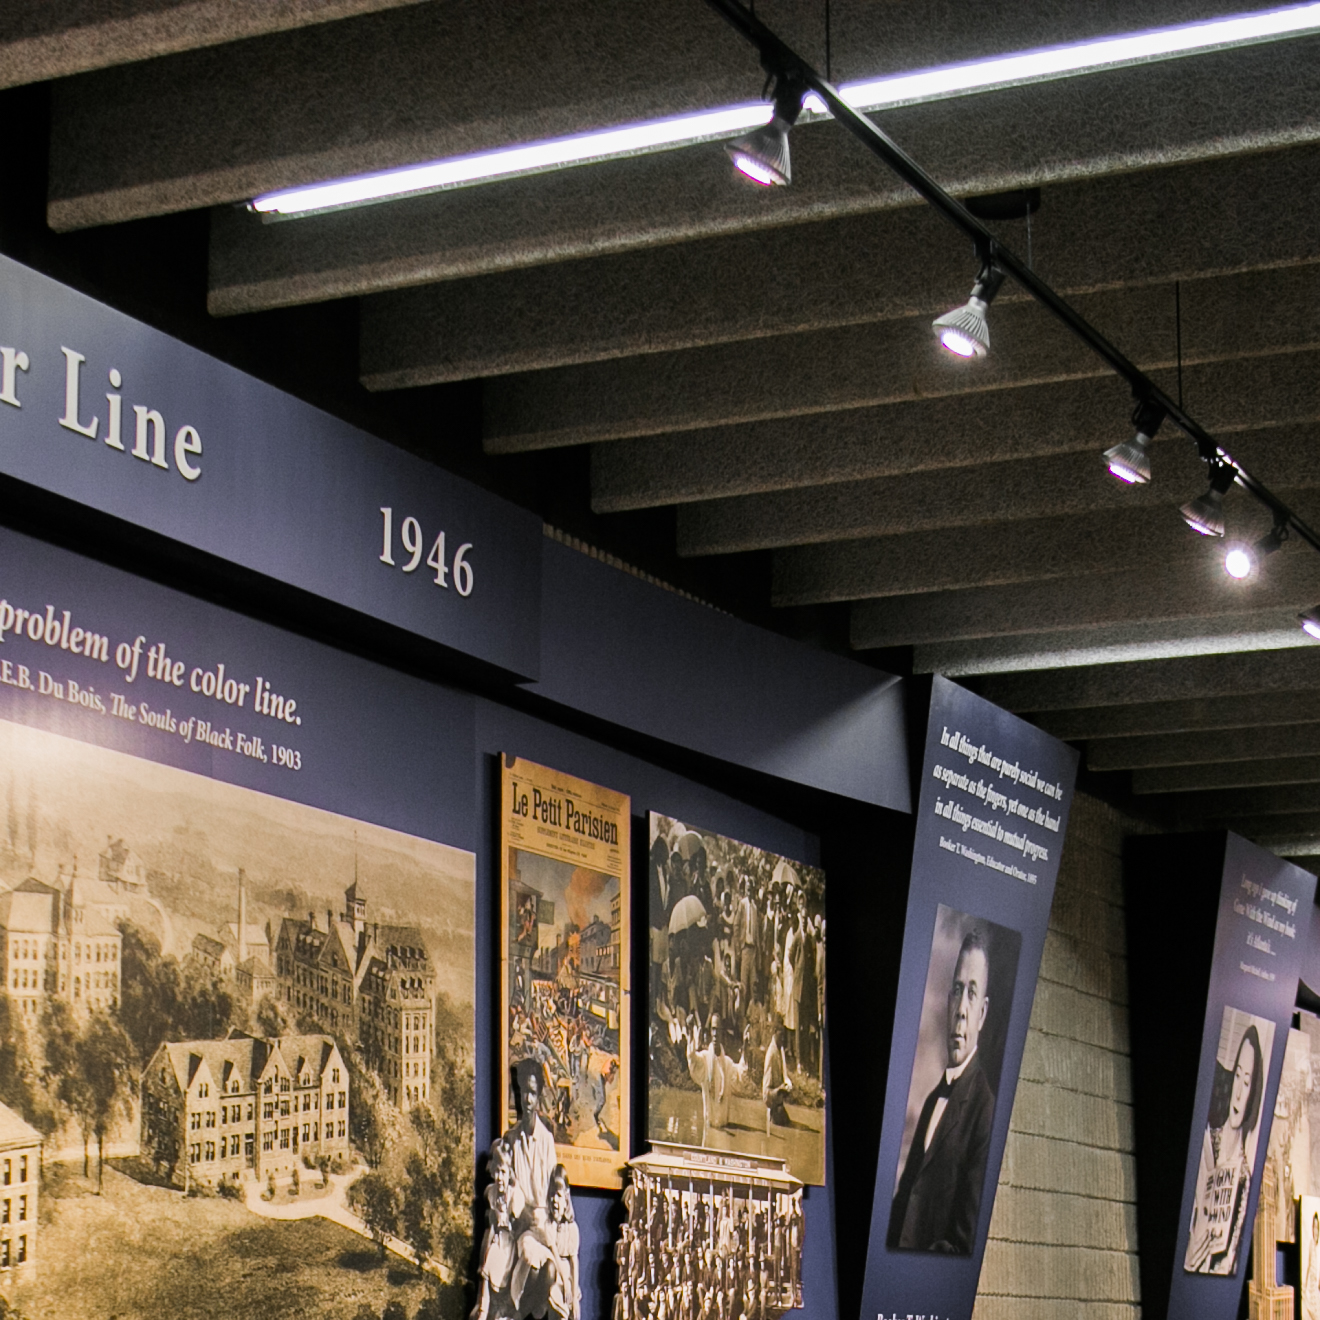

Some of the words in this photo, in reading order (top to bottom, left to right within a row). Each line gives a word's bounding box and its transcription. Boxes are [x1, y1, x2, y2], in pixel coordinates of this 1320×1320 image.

[58, 346, 204, 481] Line
[379, 507, 474, 597] 1946
[115, 635, 146, 682] of
[147, 643, 185, 686] the
[190, 664, 250, 706] color
[254, 677, 302, 725] line.
[38, 670, 64, 699] Du
[68, 679, 106, 715] Bois,
[110, 692, 137, 721] The
[138, 702, 177, 733] Souls
[179, 717, 196, 743] of
[195, 720, 233, 750] Black
[235, 733, 268, 763] Folk,
[271, 744, 302, 770] 1903
[941, 727, 950, 746] In
[949, 731, 960, 750] all
[959, 735, 978, 764] things
[978, 745, 992, 766] that
[991, 756, 1002, 771] are
[999, 760, 1020, 784] purely
[1019, 770, 1038, 788] social
[1037, 778, 1046, 792] we
[1044, 783, 1055, 797] can
[1055, 783, 1063, 800] be
[512, 782, 528, 818] Le
[533, 788, 562, 828] Petit
[565, 798, 619, 845] Parisien
[933, 764, 942, 778] as
[941, 768, 969, 791] separate
[968, 780, 977, 794] as
[976, 779, 987, 799] the
[984, 783, 1008, 811] fingers,
[1006, 799, 1018, 815] yet
[1017, 803, 1029, 818] one
[1028, 808, 1036, 821] as
[1035, 807, 1045, 825] the
[1044, 811, 1061, 832] hand
[935, 797, 943, 815] in
[943, 801, 954, 819] all
[952, 804, 972, 832] things
[971, 817, 998, 838] essential
[997, 826, 1004, 841] to
[1003, 832, 1027, 850] mutual
[939, 836, 956, 852] Booker
[1005, 865, 1013, 875] and
[1214, 1188, 1232, 1205] WITH
[1216, 1167, 1236, 1187] GONE
